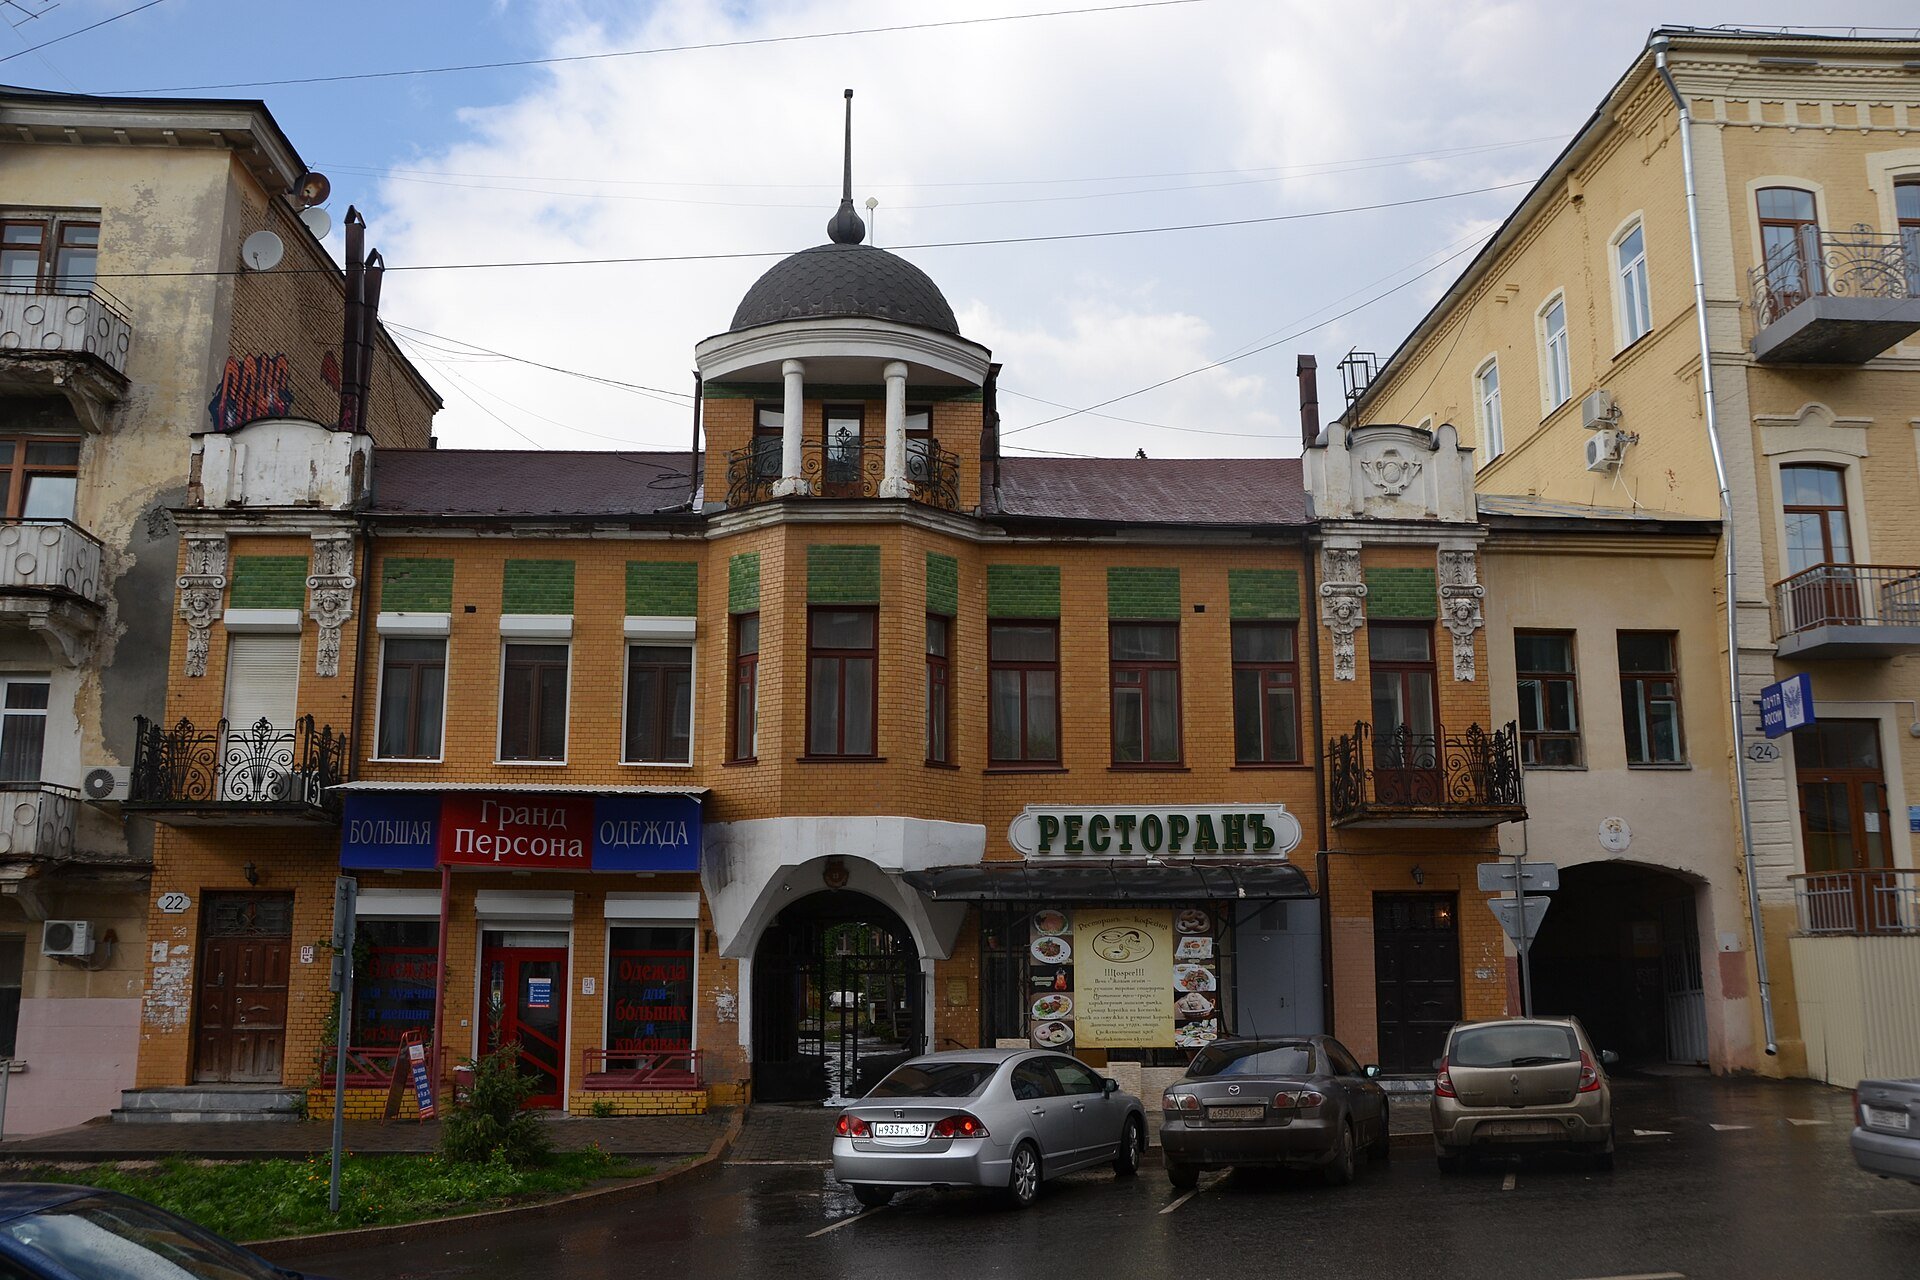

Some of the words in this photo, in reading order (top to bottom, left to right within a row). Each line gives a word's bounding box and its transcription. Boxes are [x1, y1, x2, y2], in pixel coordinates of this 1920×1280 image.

[1763, 693, 1781, 710] ПОЧТА
[1755, 746, 1772, 760] 24
[479, 799, 567, 831] Гранд
[349, 819, 431, 845] БОЛЬШАЯ
[599, 820, 689, 850] ОДЕЖДА
[1037, 813, 1276, 853] РЕСТОРАНЪ
[455, 828, 584, 861] Персона
[164, 895, 184, 911] 22
[619, 959, 688, 984] Одежда
[642, 987, 667, 1001] для
[615, 997, 689, 1021] больших
[878, 1124, 910, 1135] Н933ТХ
[912, 1124, 924, 1132] 163
